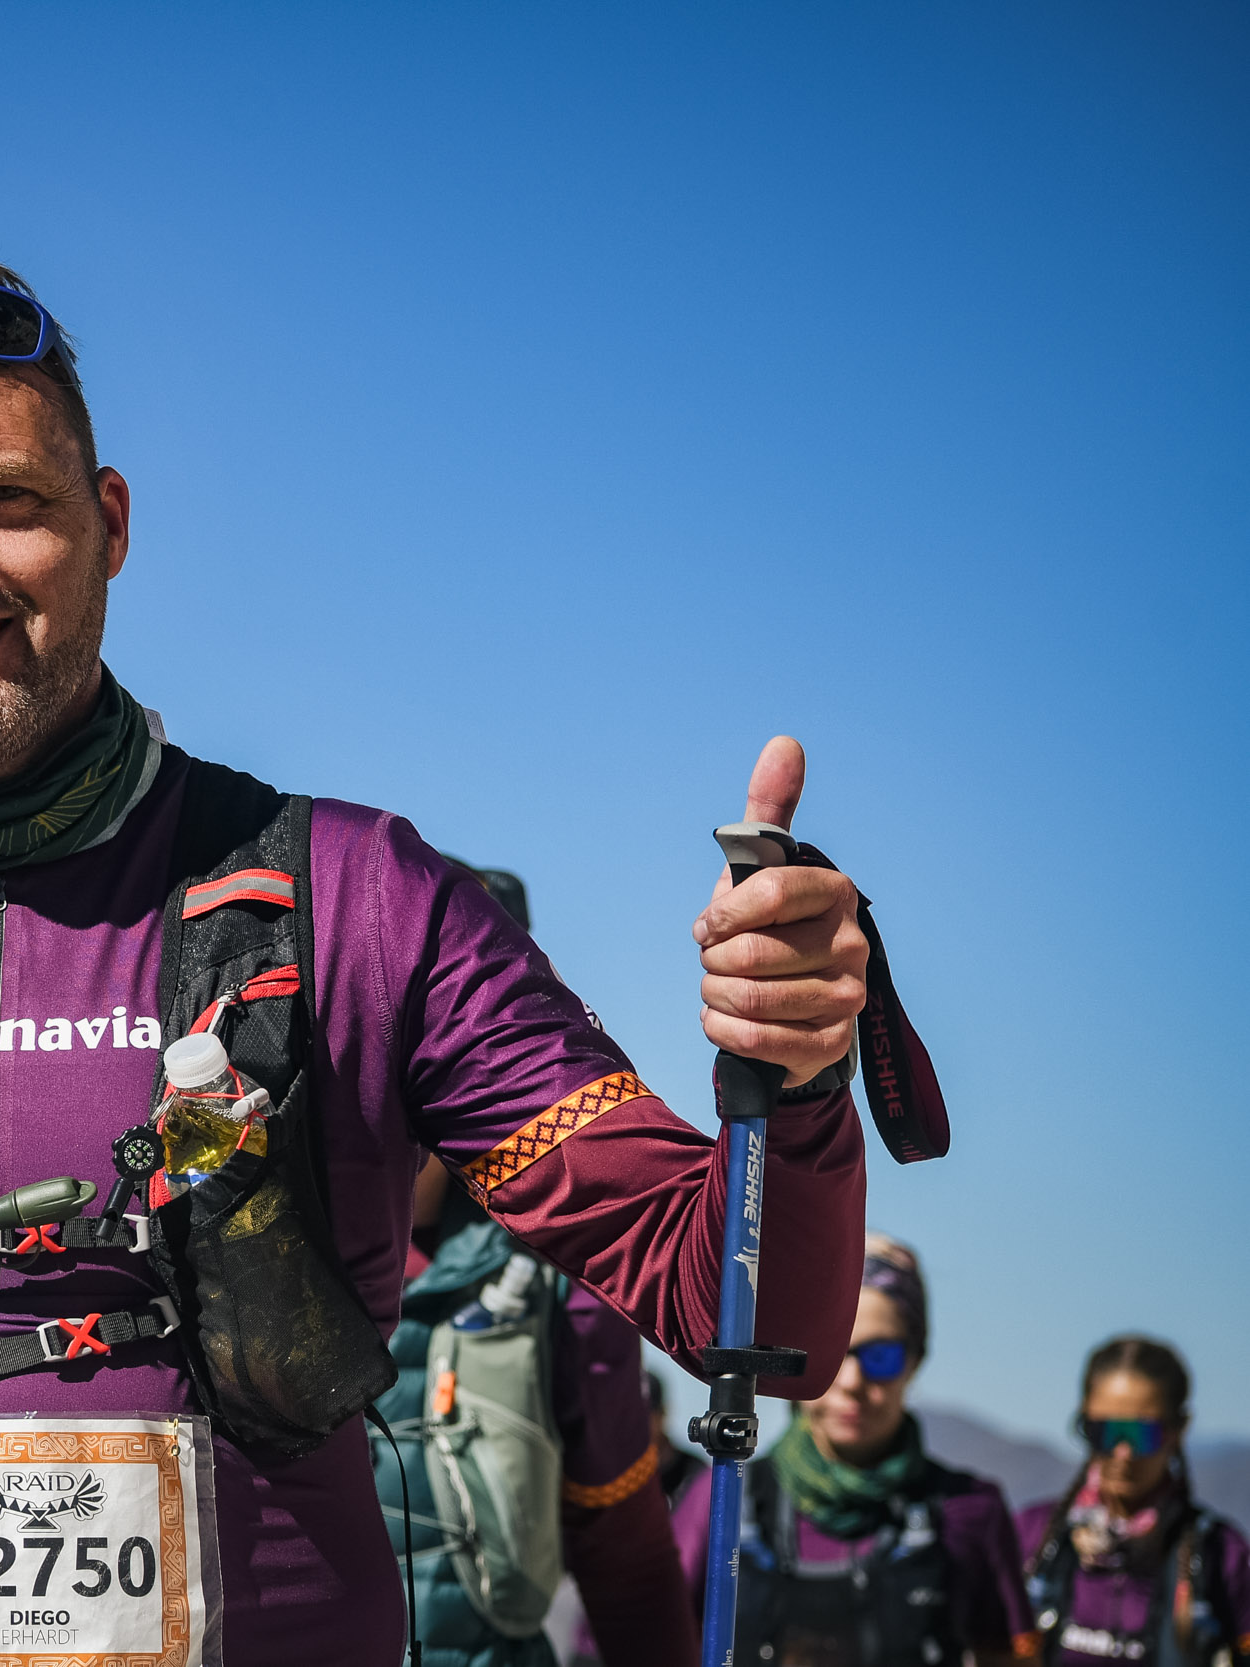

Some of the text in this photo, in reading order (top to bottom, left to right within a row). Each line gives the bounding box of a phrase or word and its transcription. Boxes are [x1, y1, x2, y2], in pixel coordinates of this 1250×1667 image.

[868, 989, 905, 1118] ZHSHHE
[743, 1130, 762, 1223] ZHSHHE
[7, 1474, 75, 1491] RAID
[10, 1611, 70, 1626] DIEGO
[2, 1629, 80, 1645] ERHARDT
